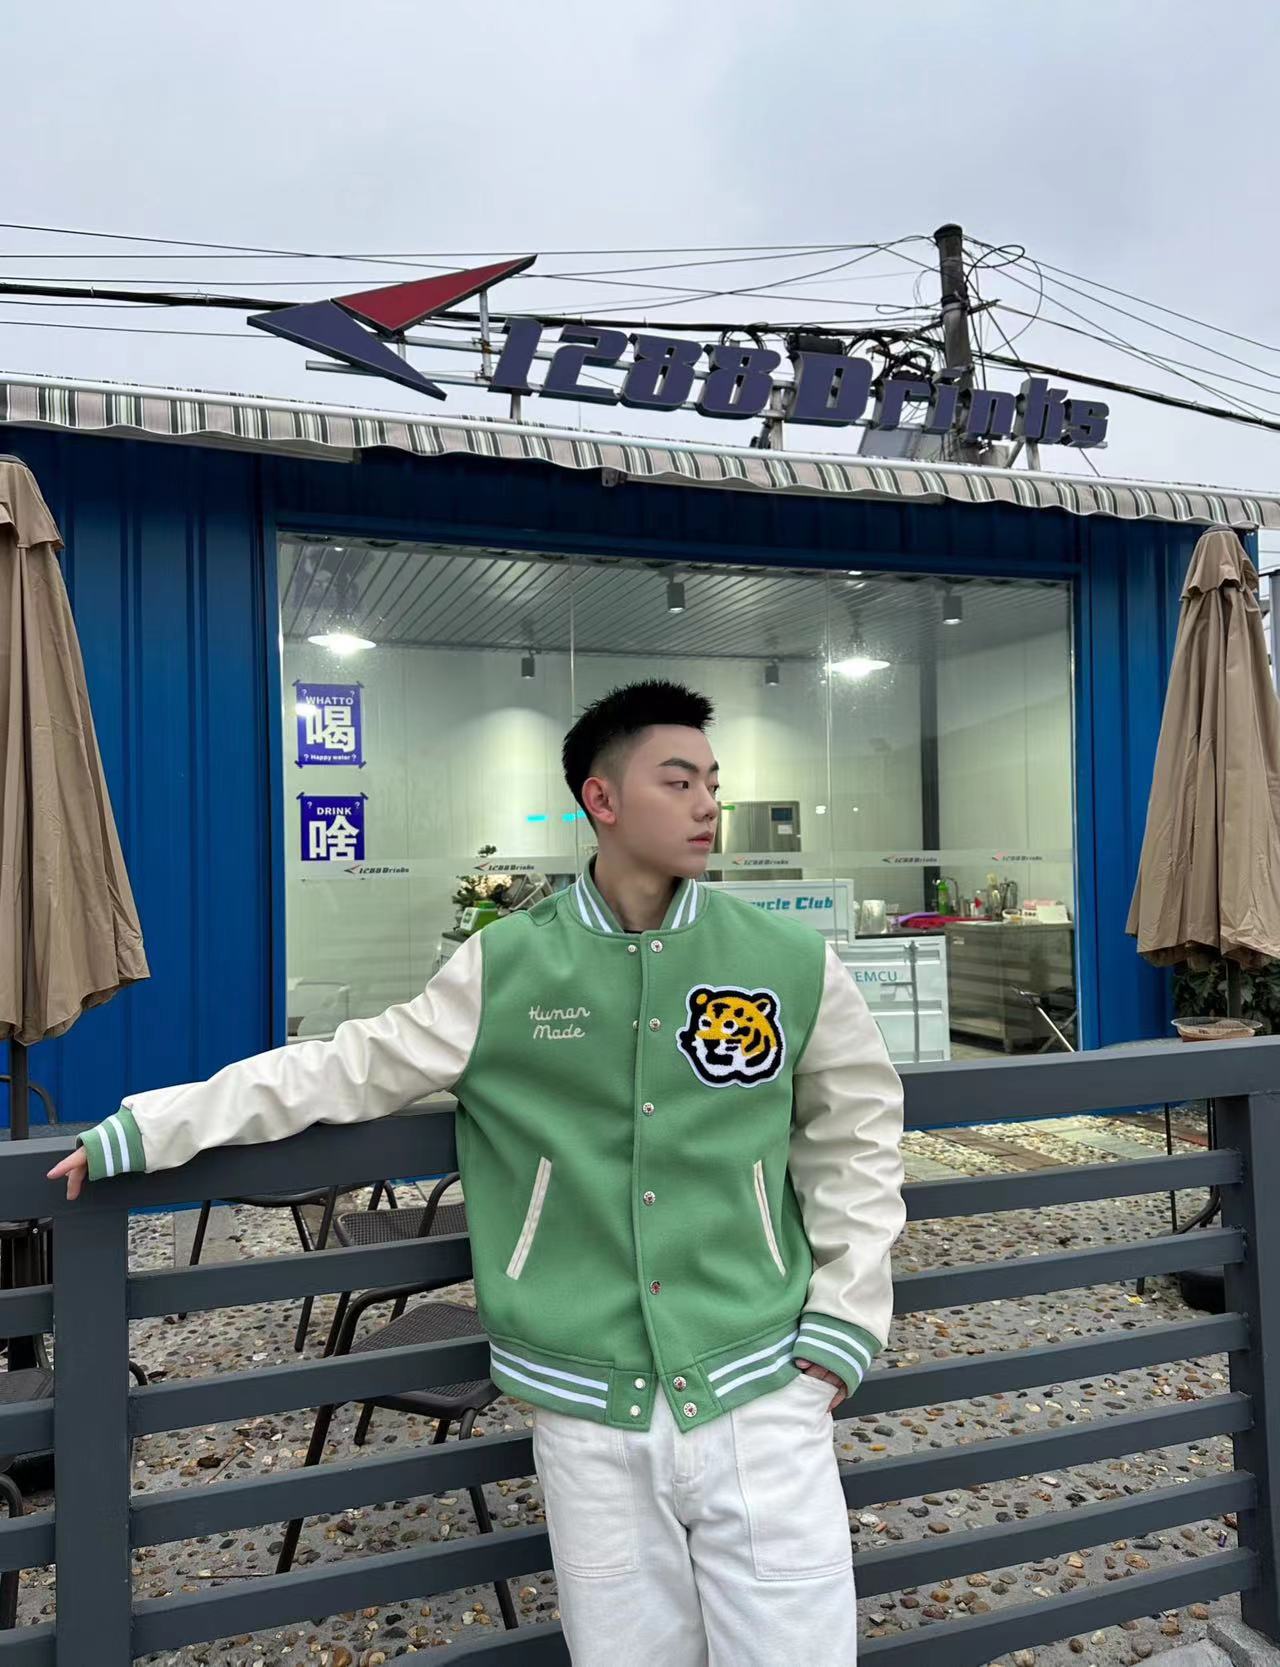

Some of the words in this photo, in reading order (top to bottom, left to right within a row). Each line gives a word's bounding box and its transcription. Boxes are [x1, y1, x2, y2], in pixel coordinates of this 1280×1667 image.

[304, 704, 356, 753] 喝
[316, 807, 352, 816] DRINK
[308, 815, 360, 861] 啥
[795, 896, 833, 910] Club
[855, 971, 898, 983] EMCU
[528, 1004, 591, 1021] Human
[532, 1023, 586, 1040] Made
